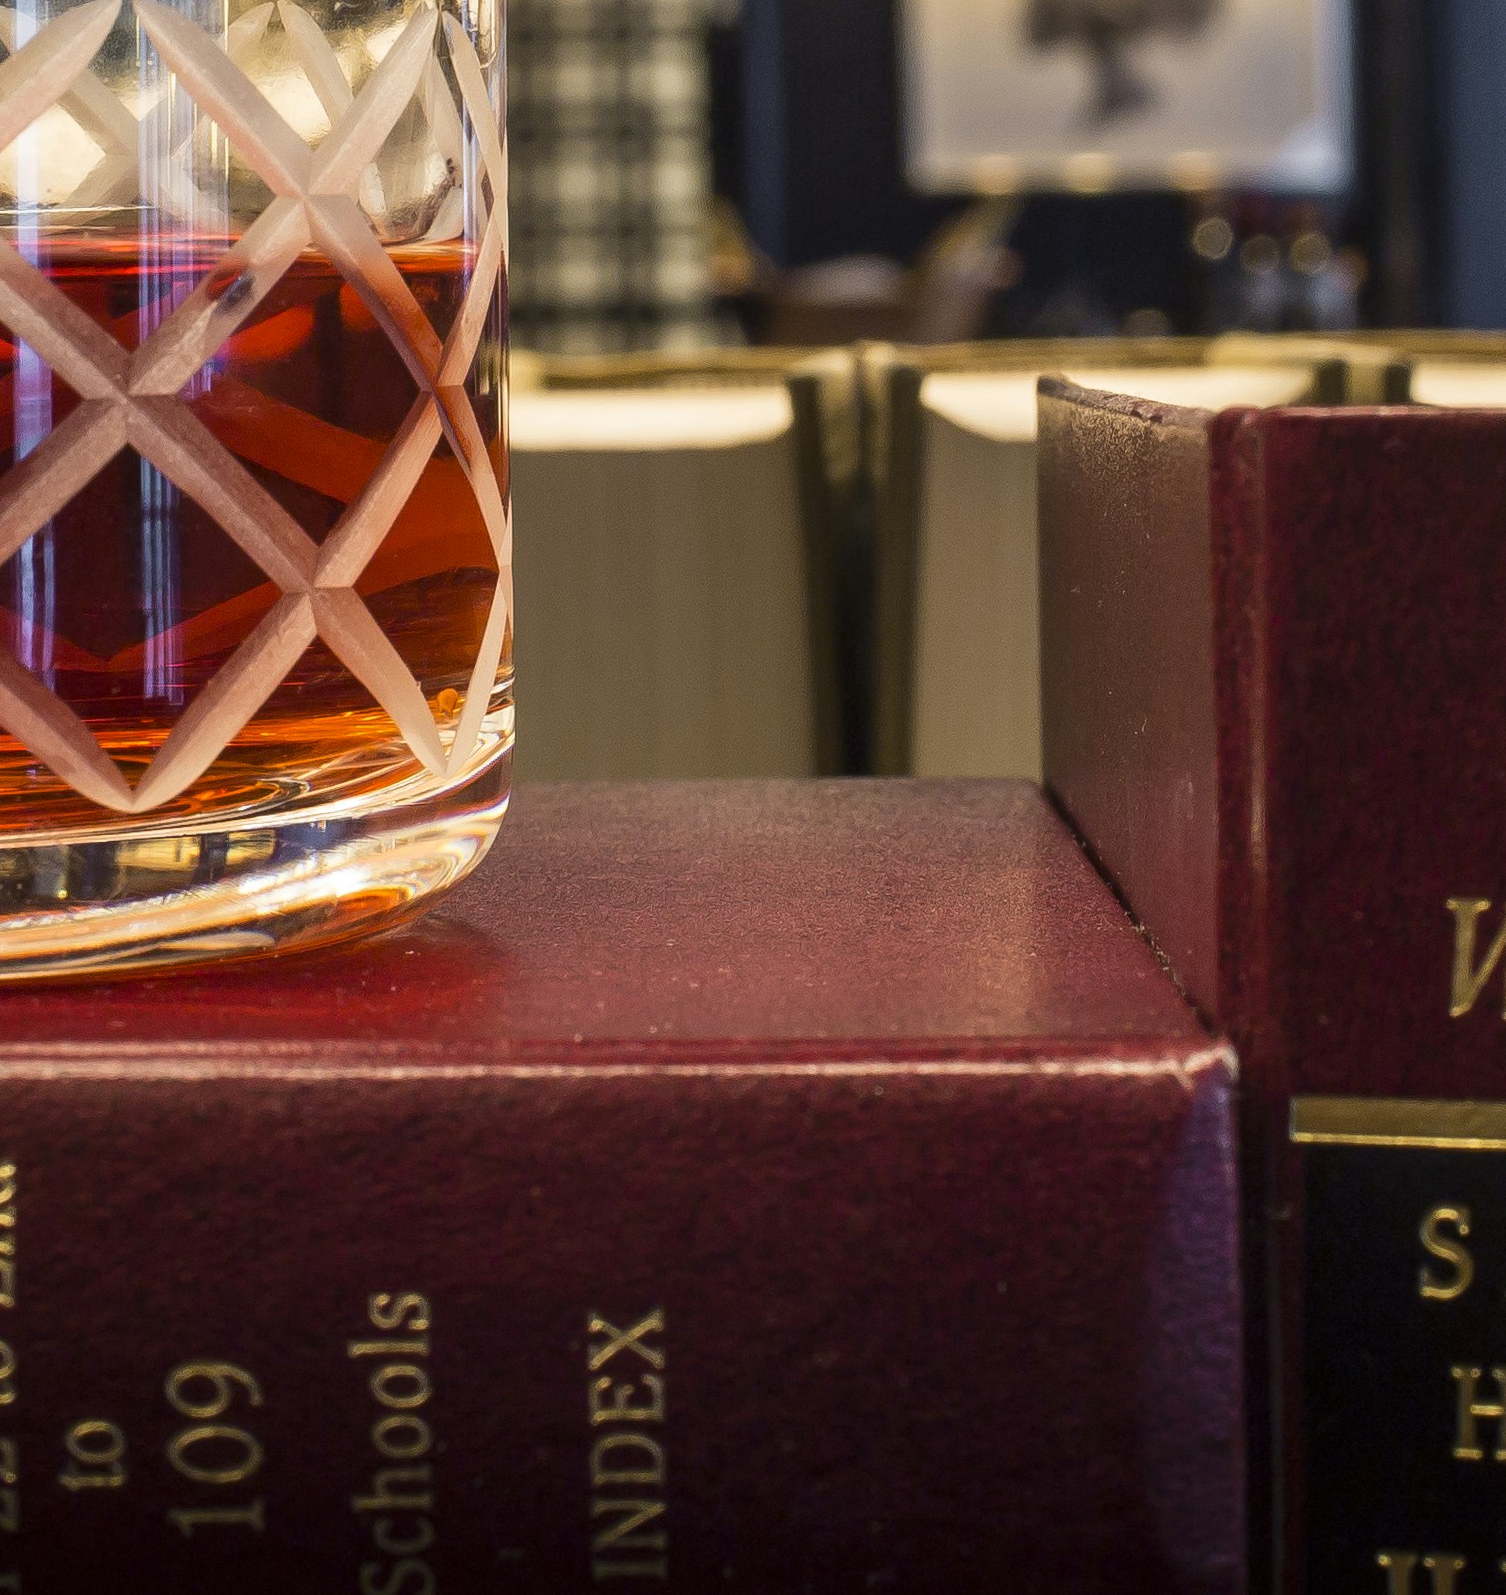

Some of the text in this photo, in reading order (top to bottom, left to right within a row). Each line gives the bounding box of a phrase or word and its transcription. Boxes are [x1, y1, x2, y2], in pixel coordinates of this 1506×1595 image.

[59, 1418, 127, 1491] to
[166, 1359, 266, 1538] 109
[347, 1291, 437, 1595] Schools
[589, 1306, 669, 1582] INDEX
